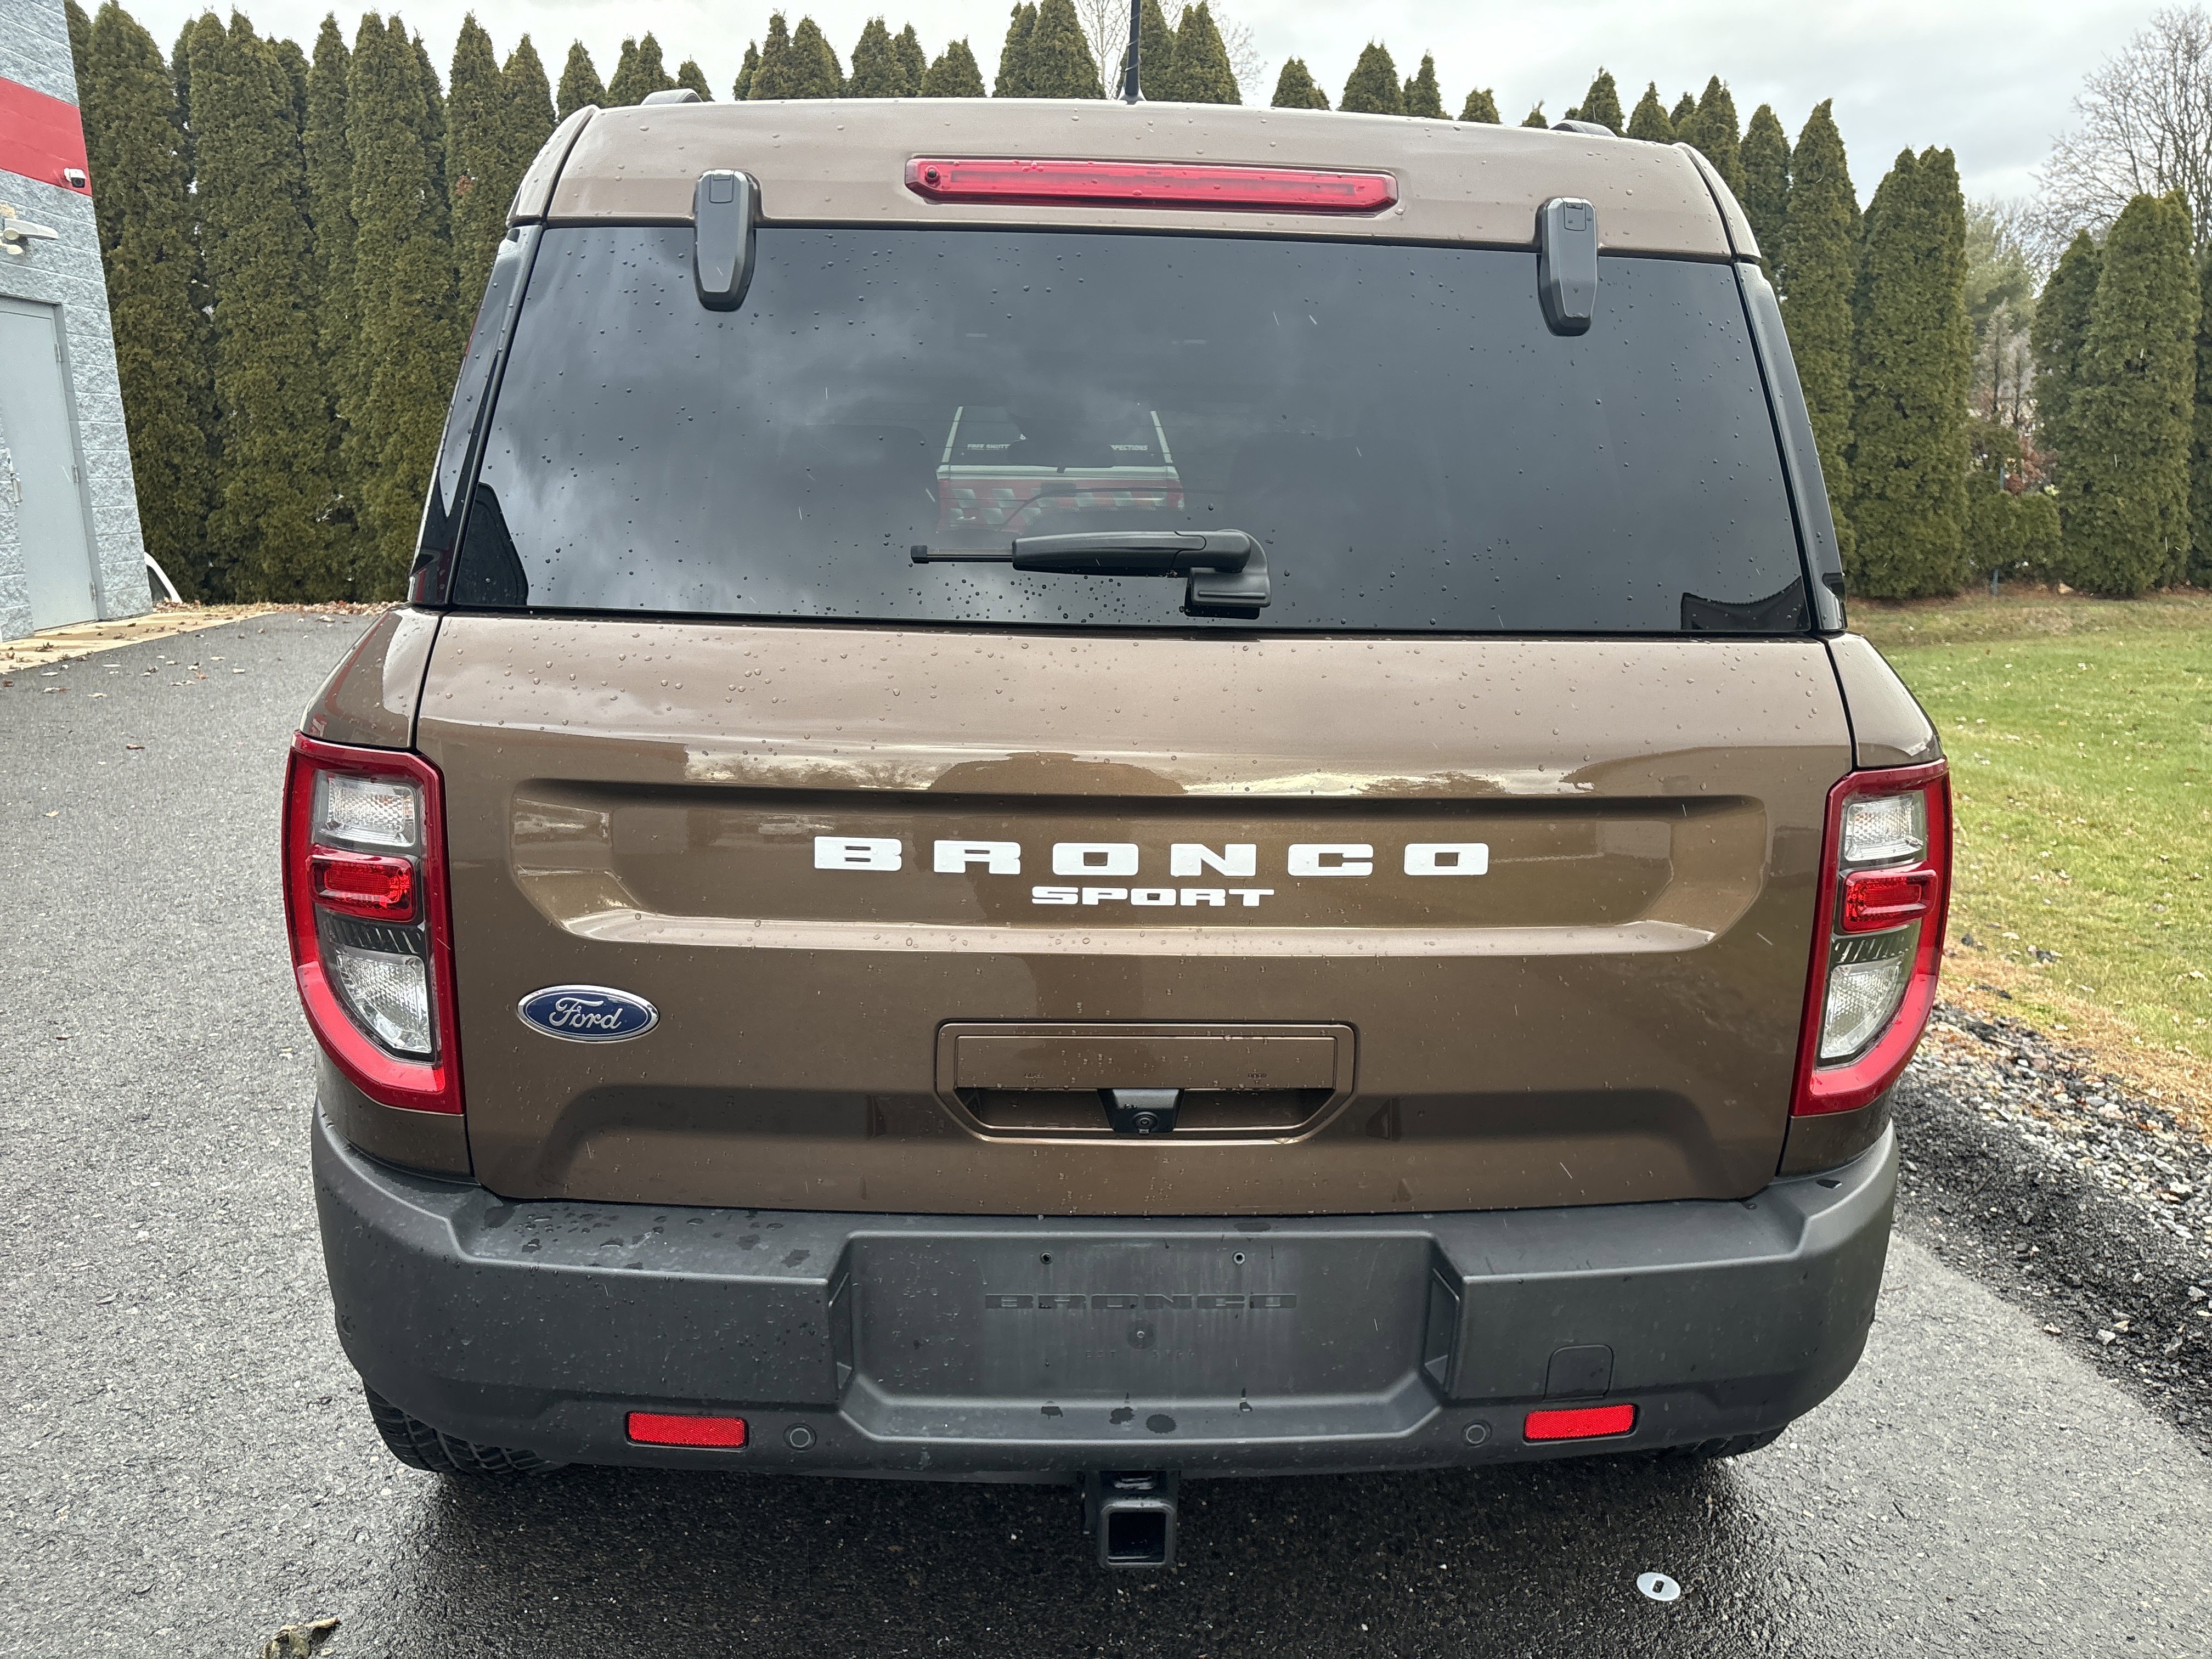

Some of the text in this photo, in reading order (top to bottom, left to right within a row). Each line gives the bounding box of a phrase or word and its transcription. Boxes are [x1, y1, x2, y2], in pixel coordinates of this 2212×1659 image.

[814, 836, 1489, 877] BRONCO
[1032, 886, 1274, 907] SPORT
[549, 997, 623, 1029] Ford
[985, 1293, 1297, 1310] BRONCO
